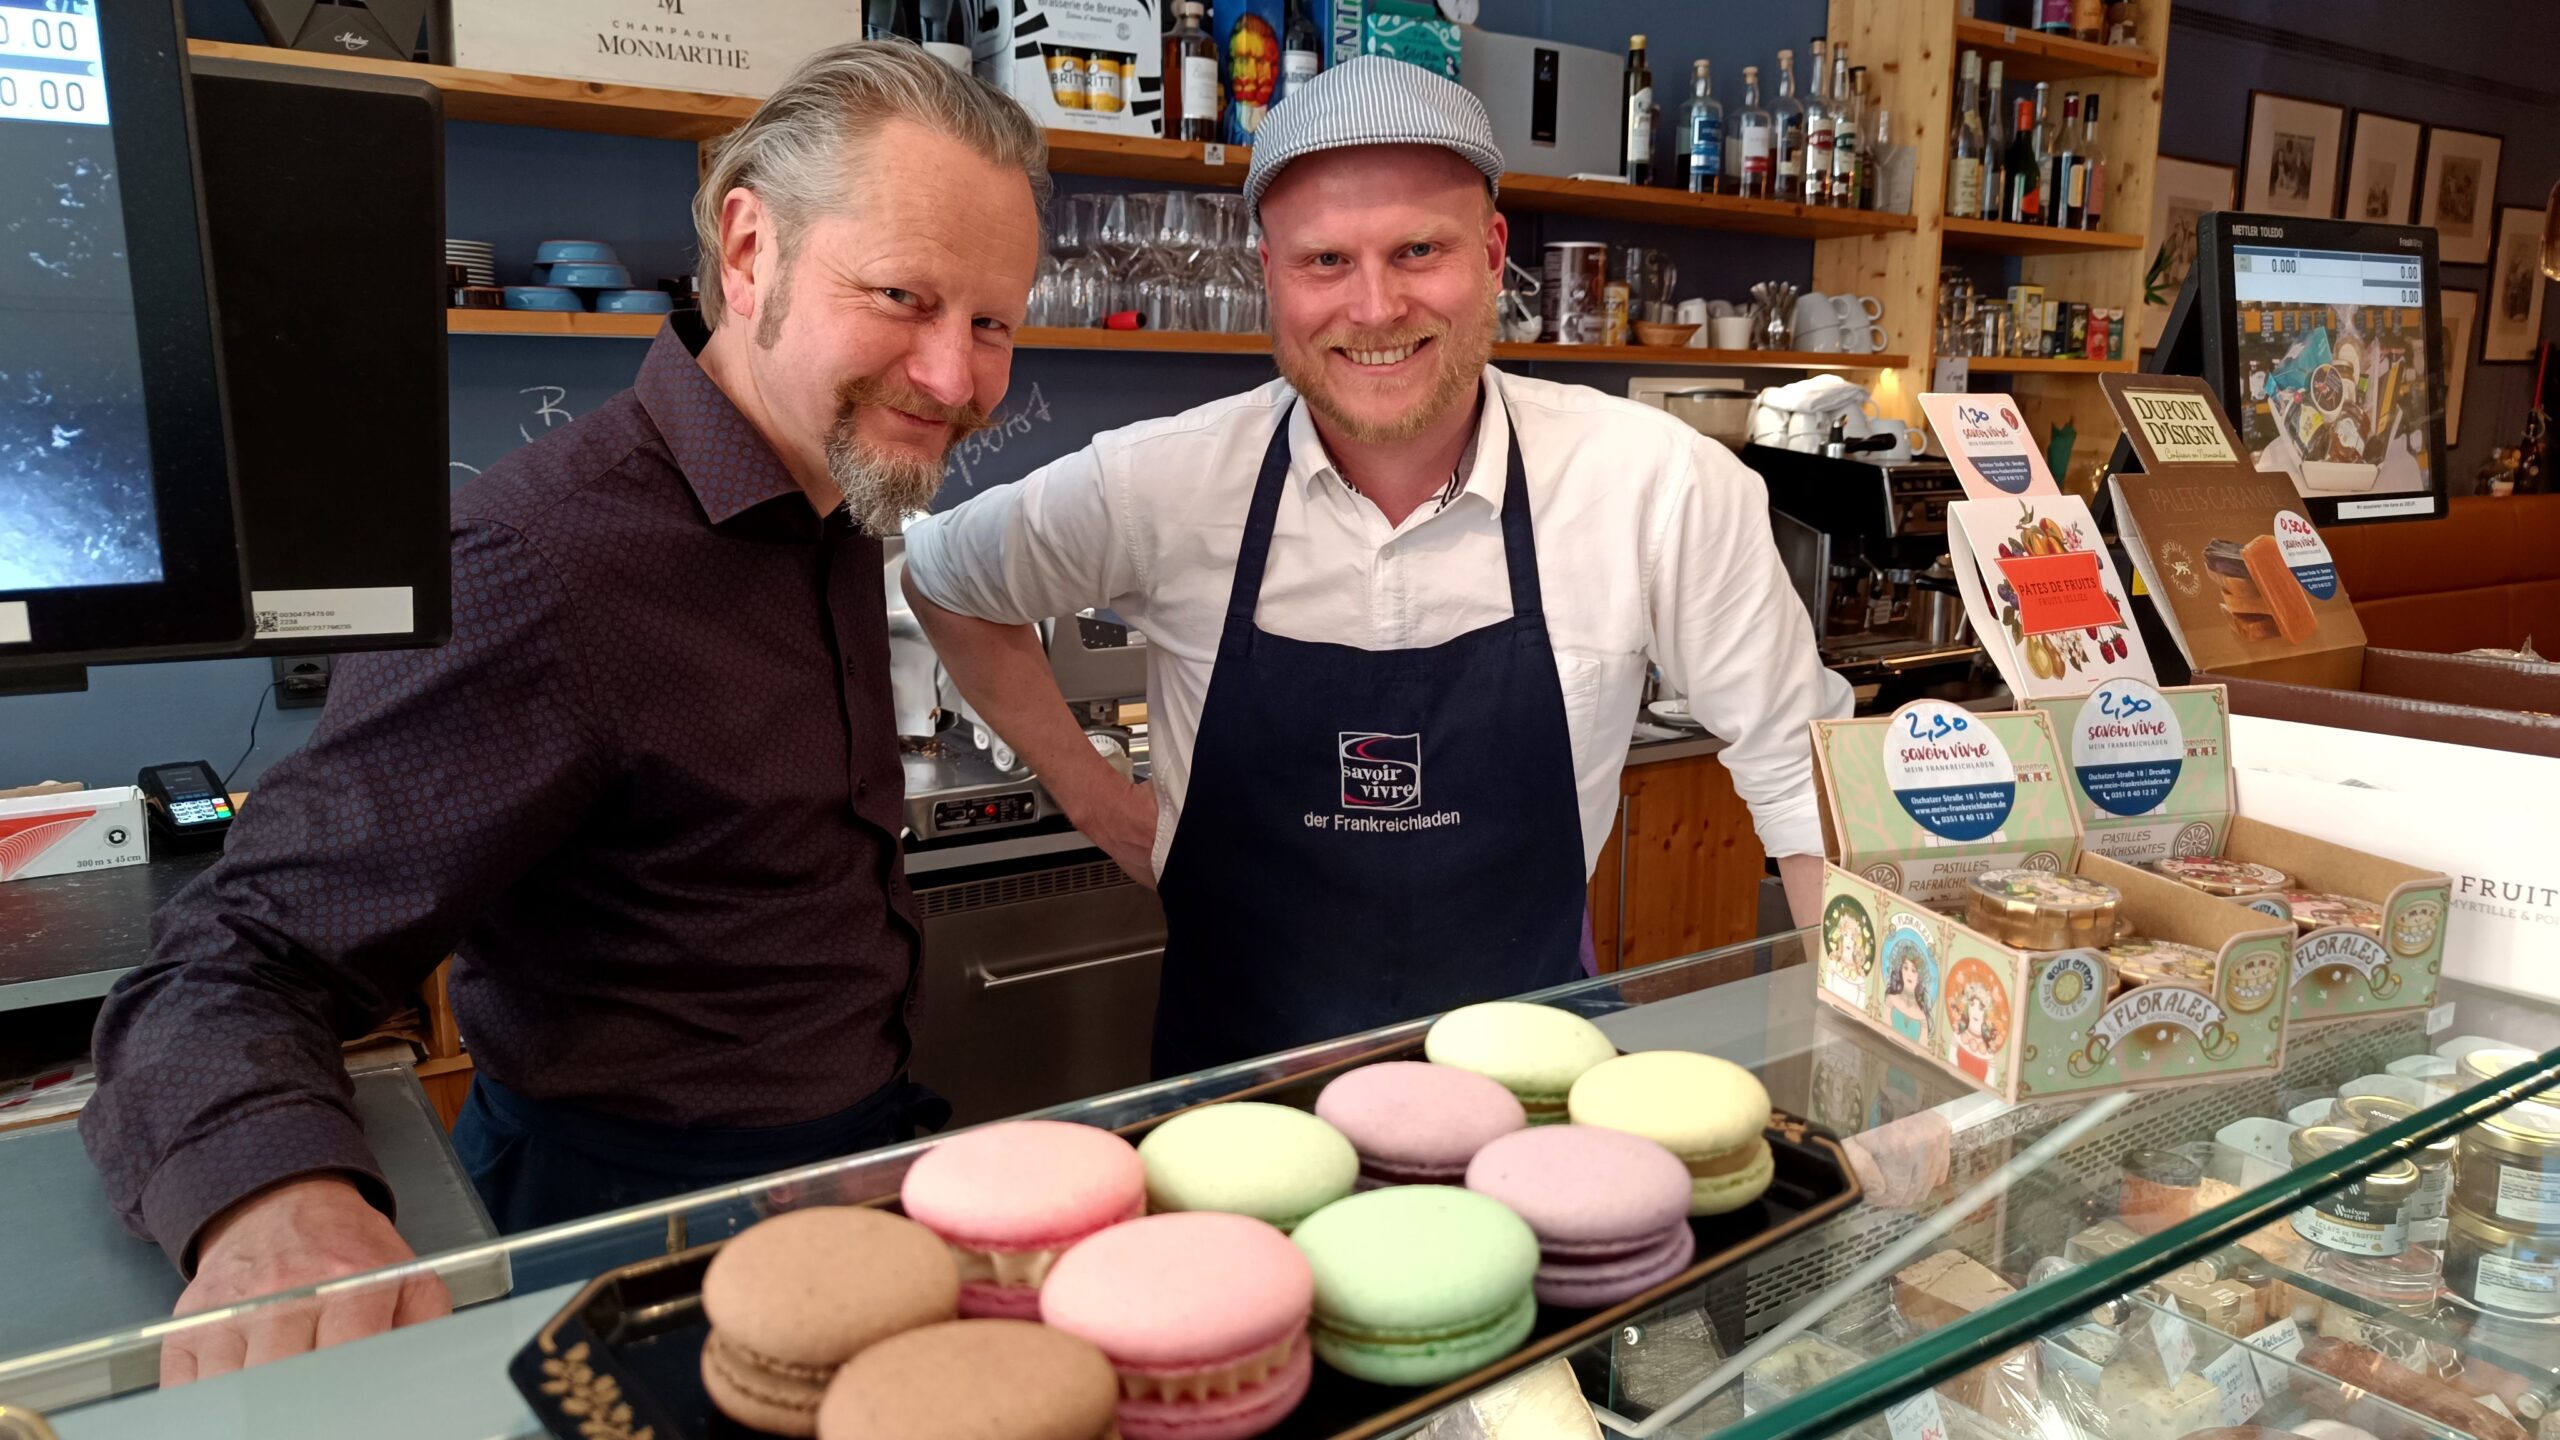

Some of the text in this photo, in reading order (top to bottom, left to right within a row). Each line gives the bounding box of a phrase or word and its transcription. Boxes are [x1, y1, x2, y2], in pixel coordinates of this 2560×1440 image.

[1083, 1, 1095, 12] de
[1097, 3, 1138, 18] Bretagne
[612, 20, 731, 43] CHAMPAGNE
[597, 33, 750, 70] MONMARTHE
[2232, 224, 2284, 239] METTLER TOLEDO
[2272, 259, 2297, 274] 0.000
[2401, 266, 2418, 280] 0.00
[2402, 290, 2419, 304] 0.00
[2132, 396, 2208, 421] DUPONT
[1959, 405, 1989, 429] 1,30
[2148, 485, 2285, 512] PALETS CARAMEL
[2049, 580, 2063, 593] DE
[2065, 577, 2097, 592] FRUITS
[2099, 691, 2152, 720] 2,90
[1905, 712, 1968, 742] 2,90
[2088, 719, 2167, 741] savoir vivre
[1901, 741, 1990, 764] savoir vivre
[2107, 740, 2168, 749] FRANKREICHLADEN
[1904, 761, 1995, 774] MEIN FRANKREICHLADEN
[2088, 771, 2115, 780] Oschatzer
[2116, 769, 2135, 779] Straße
[2148, 768, 2171, 776] Dresden
[1342, 764, 1414, 799] savoir vivre
[2089, 778, 2171, 790] www.mein-frankreichladen.de
[1911, 796, 1941, 805] Oschatzer
[1942, 793, 1964, 802] Straße
[1979, 791, 2005, 799] Dresden
[2111, 791, 2126, 799] 0351
[1914, 801, 2007, 815] www.mein-frankreichladen.de
[1303, 811, 1461, 833] der Frankreichladen
[1941, 812, 1994, 824] 0351 8 40 12 21
[2101, 830, 2152, 845] PASTILLES
[76, 859, 93, 868] 300
[114, 855, 126, 864] 45
[126, 854, 142, 863] cm
[1932, 860, 1990, 875] PASTILLES
[2460, 875, 2559, 907] FRUIT
[2450, 899, 2517, 919] MYRTILLE
[2520, 911, 2530, 921] &
[2296, 936, 2379, 967] FLORALES
[2114, 991, 2212, 1027] FLORALES
